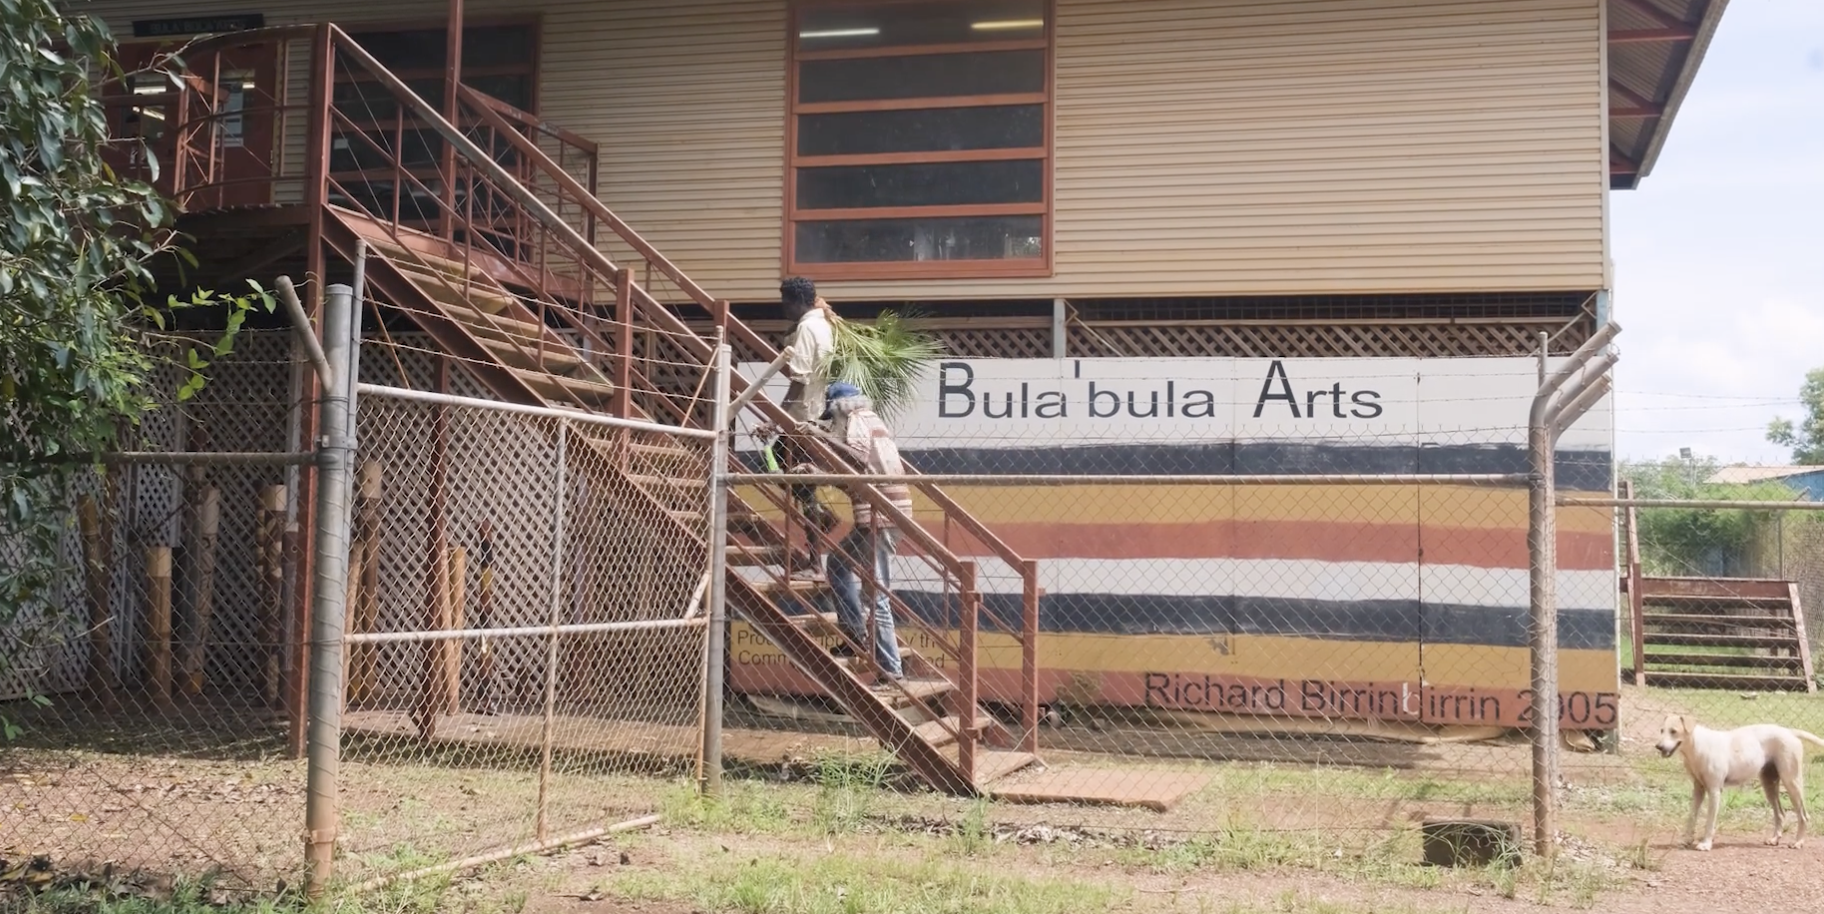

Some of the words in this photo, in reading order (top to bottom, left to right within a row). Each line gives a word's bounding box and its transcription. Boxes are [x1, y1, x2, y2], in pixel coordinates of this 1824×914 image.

[1252, 360, 1383, 418] Arts
[1145, 673, 1285, 714] Richard
[1517, 687, 1616, 725] 205
